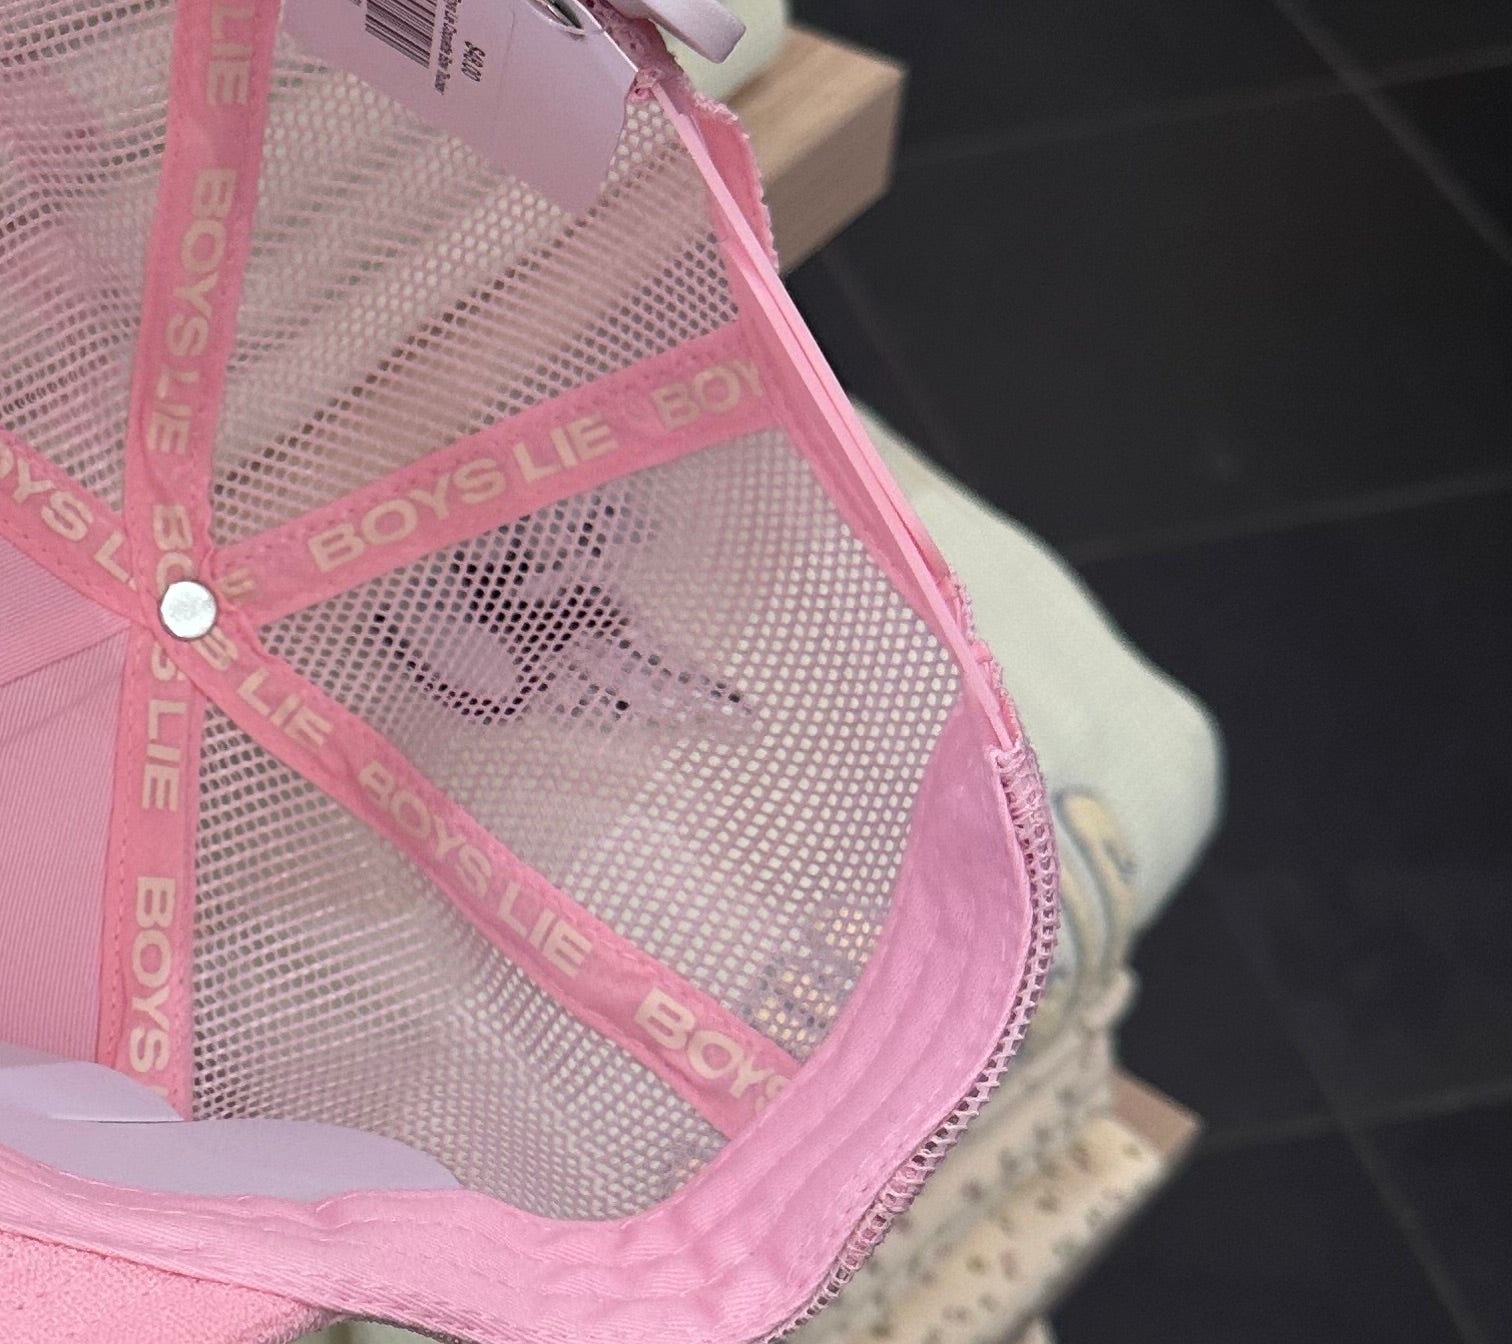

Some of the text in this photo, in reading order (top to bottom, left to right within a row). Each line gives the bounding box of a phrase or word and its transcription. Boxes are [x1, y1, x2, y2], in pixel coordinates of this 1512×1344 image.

[164, 168, 238, 358] BOYS
[146, 363, 201, 455] LIE
[305, 457, 508, 574] BOYS
[511, 412, 619, 484] LIE
[141, 698, 189, 813] LIE
[239, 666, 334, 746] LIE
[357, 760, 493, 897] BOYS
[129, 875, 178, 1074] BOYS
[496, 881, 593, 979] LIE
